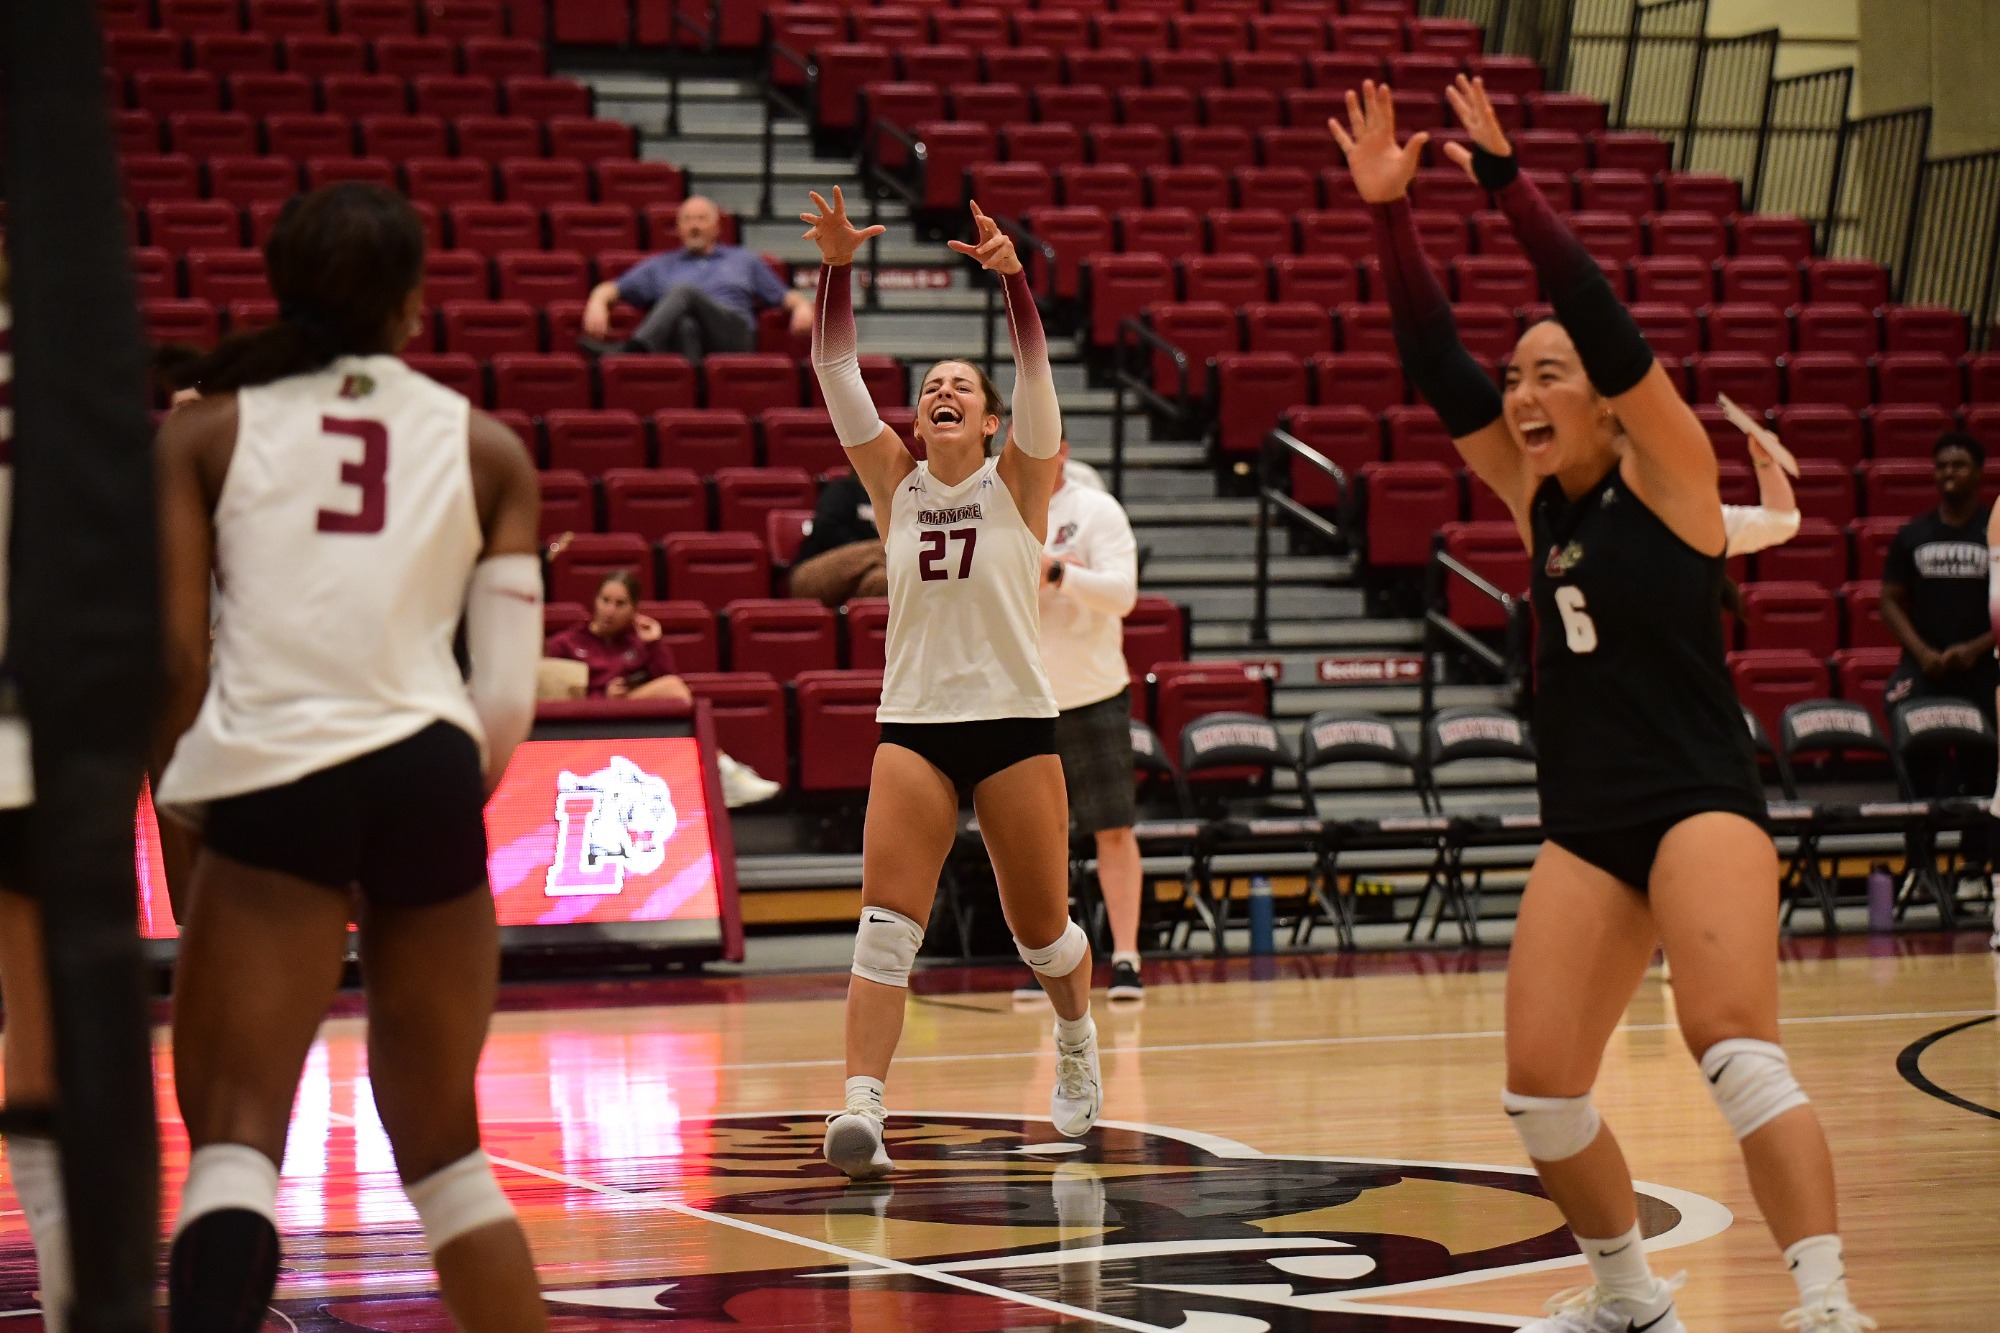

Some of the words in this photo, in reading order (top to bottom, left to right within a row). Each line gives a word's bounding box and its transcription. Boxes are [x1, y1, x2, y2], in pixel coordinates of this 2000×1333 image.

[317, 415, 388, 533] 3
[919, 528, 976, 581] 27
[1555, 585, 1598, 653] 6
[548, 792, 624, 894] L
